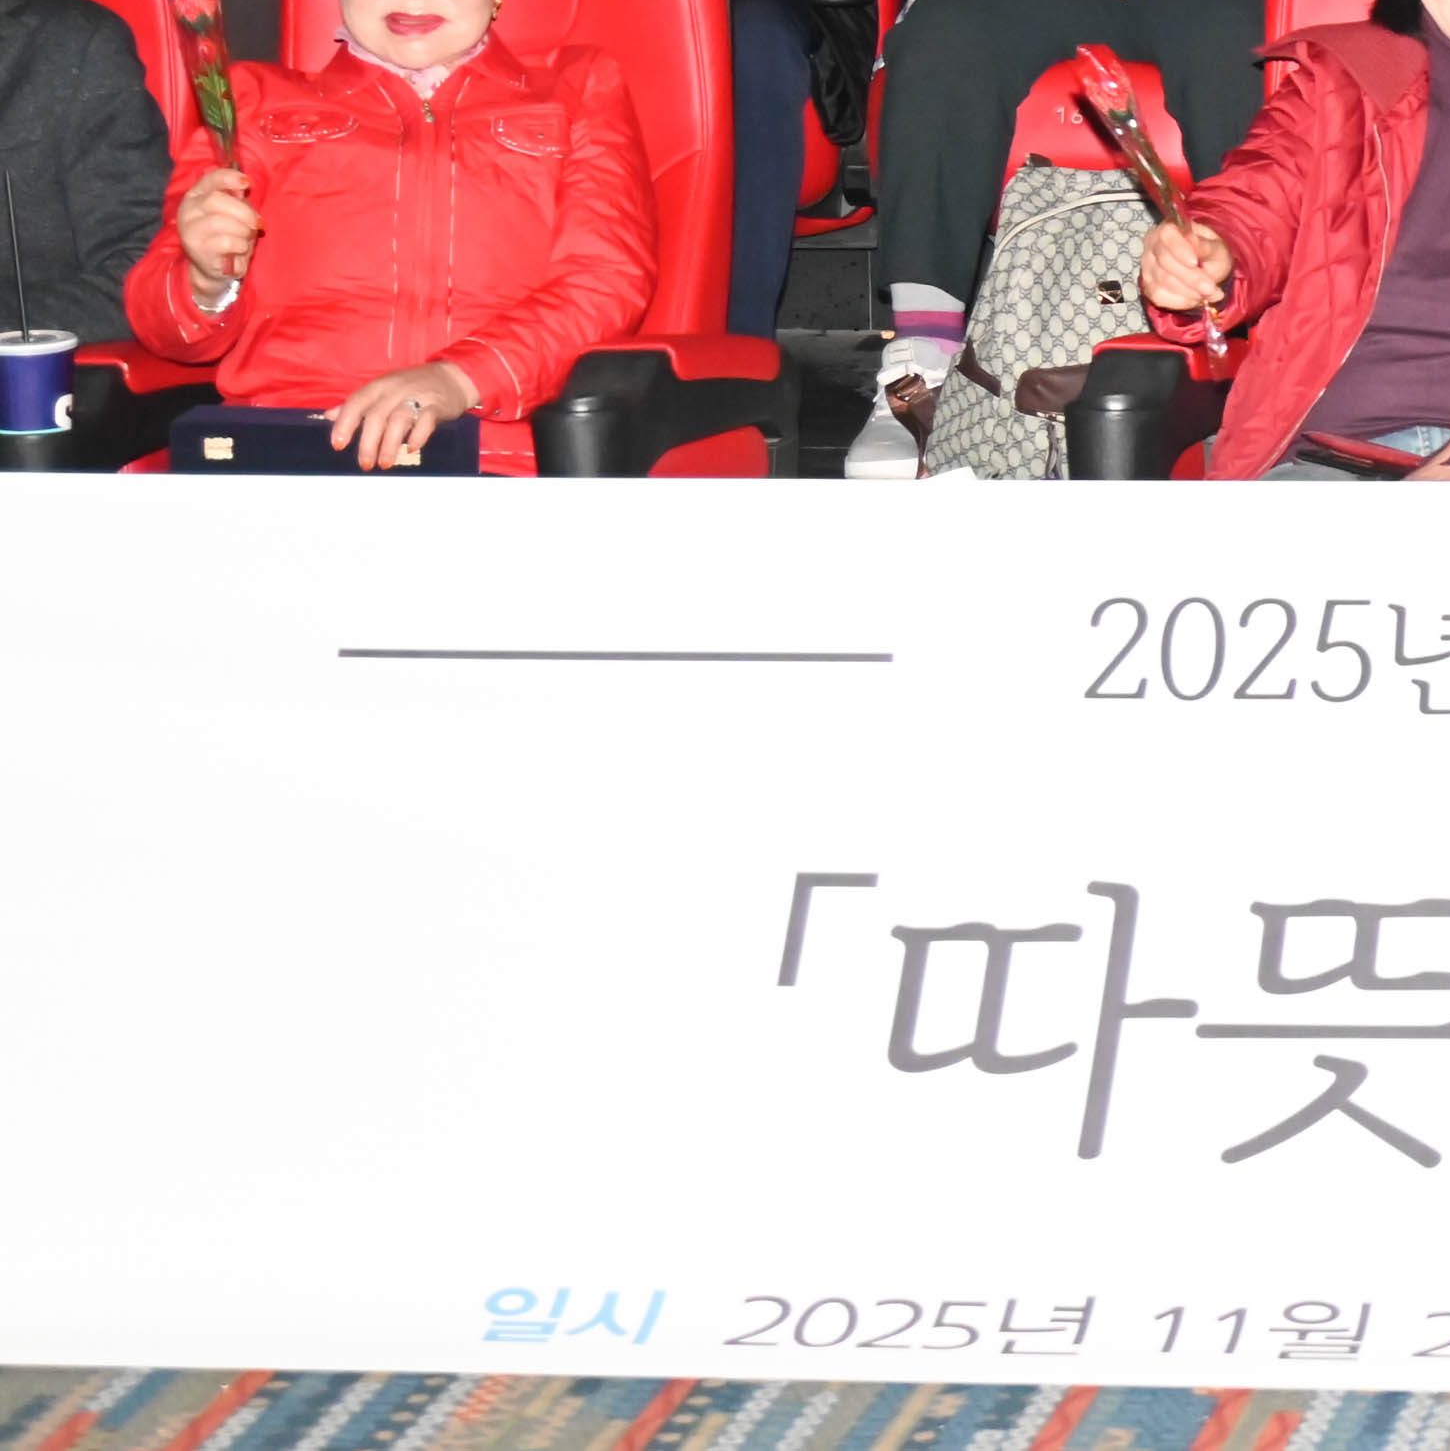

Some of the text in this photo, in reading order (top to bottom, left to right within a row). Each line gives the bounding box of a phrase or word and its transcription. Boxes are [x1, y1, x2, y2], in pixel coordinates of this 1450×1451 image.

[484, 1288, 666, 1346] 일시
[723, 1296, 1095, 1356] 2025년
[1154, 1301, 1371, 1360] 11월
